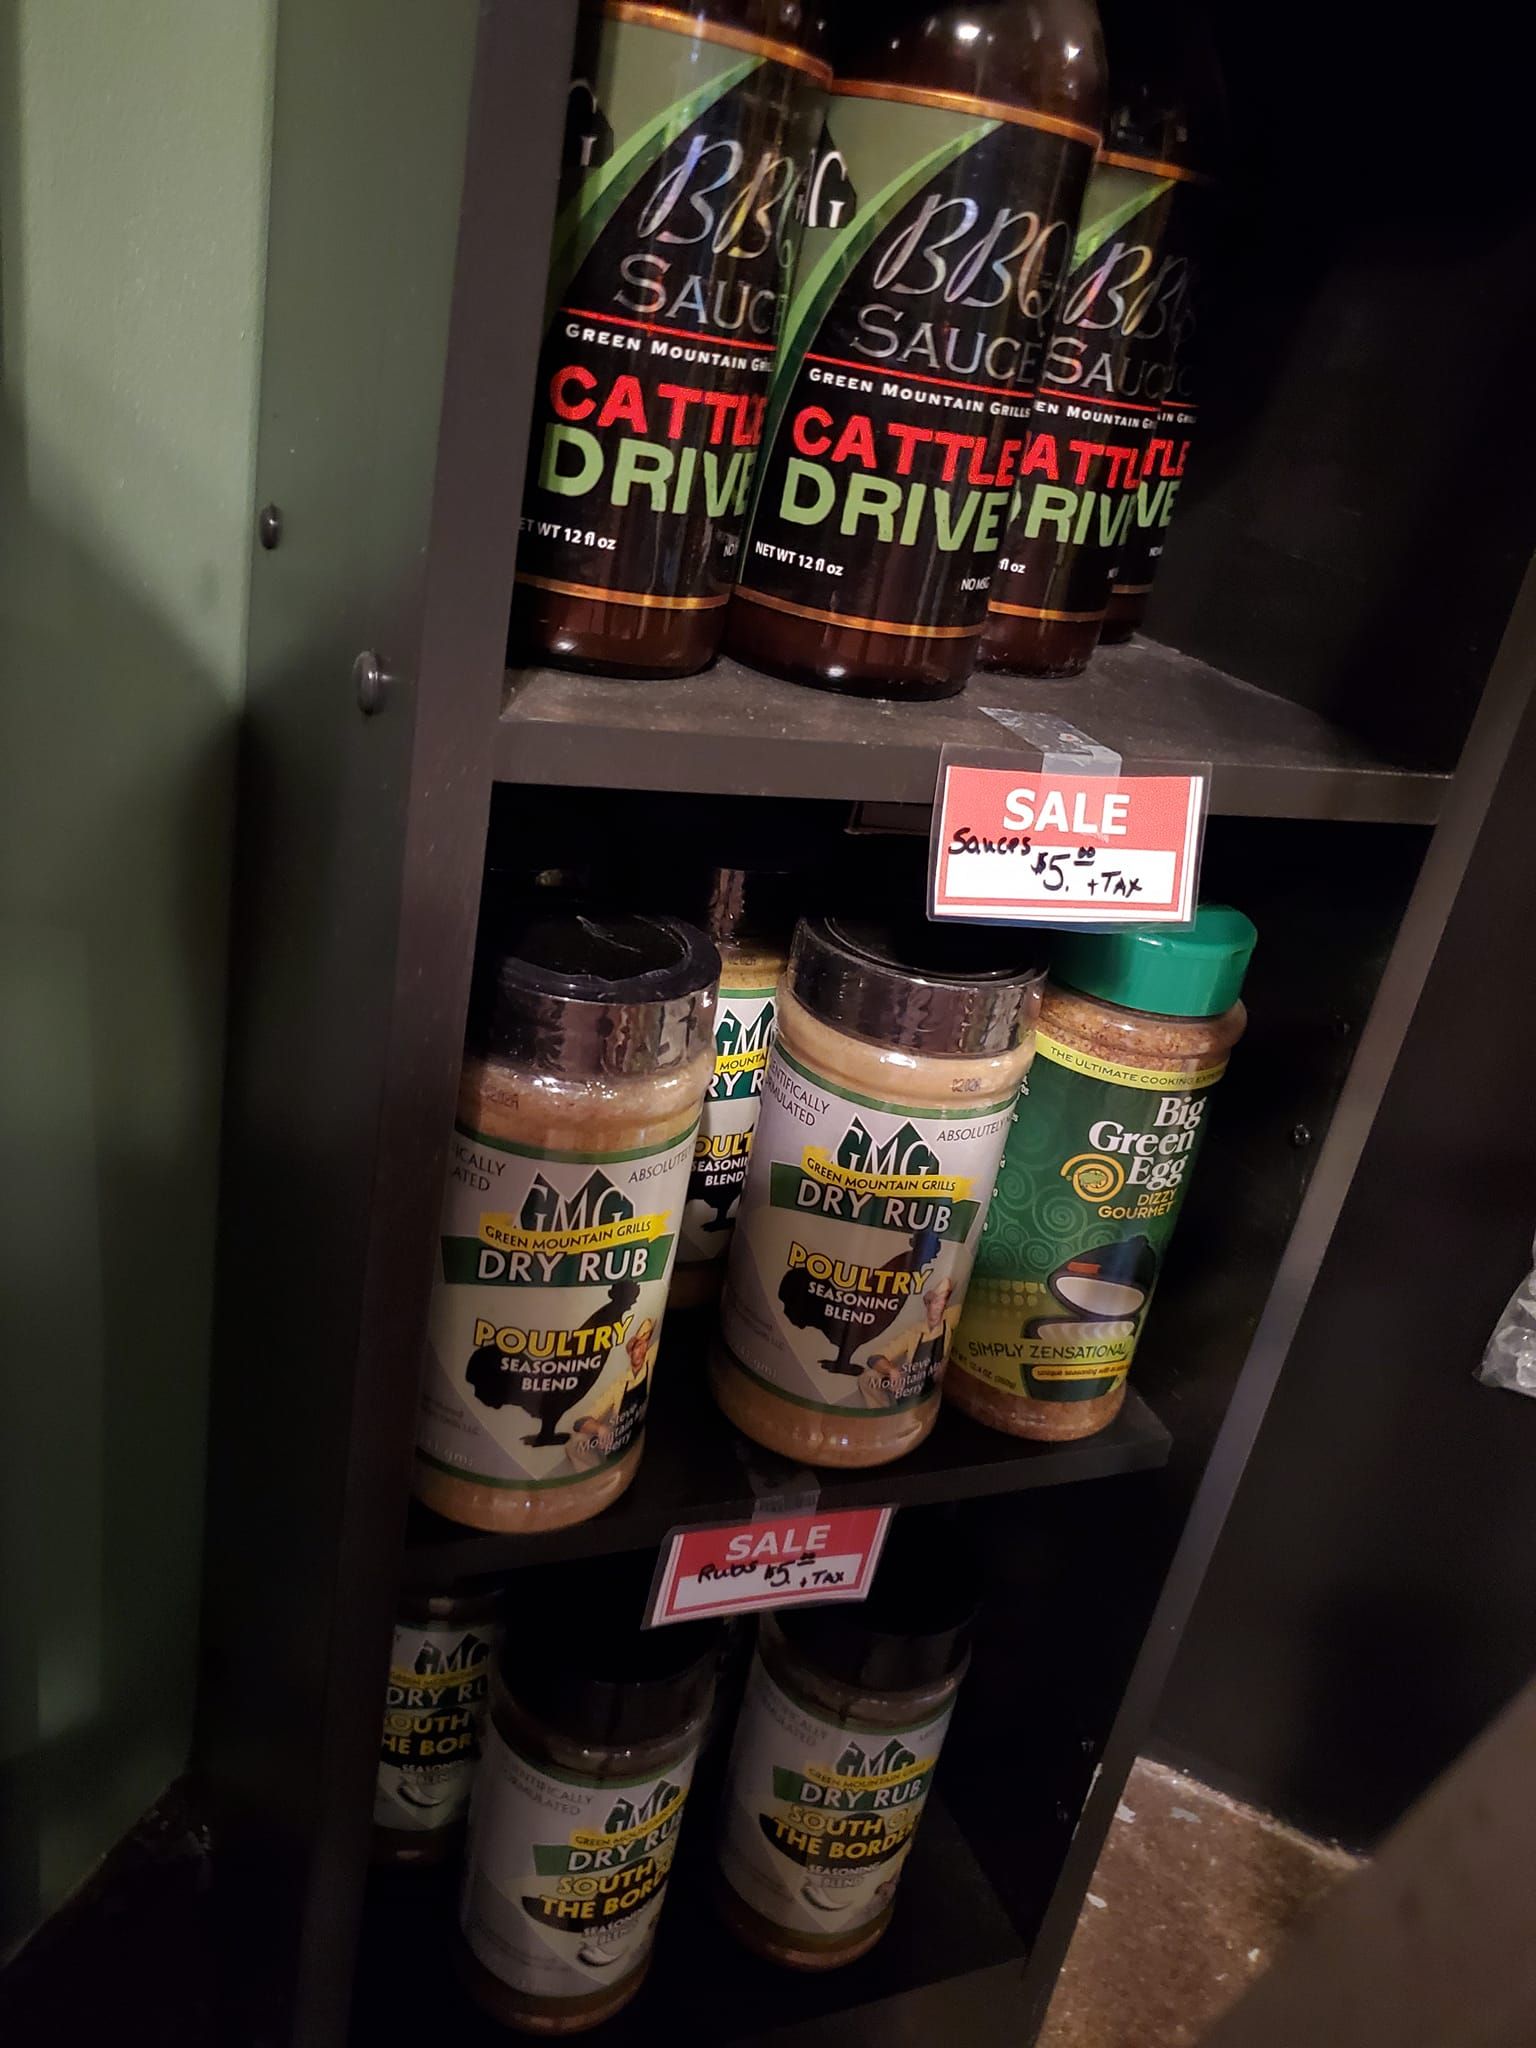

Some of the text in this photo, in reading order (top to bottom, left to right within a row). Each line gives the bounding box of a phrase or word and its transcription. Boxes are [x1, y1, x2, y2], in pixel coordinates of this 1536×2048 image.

[565, 323, 641, 351] GREEN
[651, 340, 747, 370] MOUNTAIN
[850, 303, 1036, 383] SAUCE
[809, 368, 873, 393] GREEN
[882, 382, 984, 412] MOUNTAIN
[990, 402, 1031, 418] GRILLS
[1066, 406, 1140, 428] MOUNTAIN
[793, 406, 1021, 487] CATTLE
[779, 457, 1009, 553] DRIVE
[537, 522, 561, 539] WT
[563, 528, 581, 543] 12
[584, 529, 597, 546] fl
[597, 536, 617, 550] oz
[755, 541, 845, 577] NET WT 12 fl oz
[1010, 563, 1027, 575] oz
[1002, 787, 1131, 836] SALE
[948, 828, 1032, 855] Sauces
[719, 1053, 767, 1071] MOUNTA
[1050, 1046, 1073, 1063] THE
[1075, 1058, 1139, 1082] ULTIMATE
[1141, 1072, 1193, 1086] COOKING
[1153, 1096, 1207, 1131] Big
[836, 1120, 942, 1177] GMG
[1088, 1121, 1195, 1156] Green
[807, 1157, 956, 1192] GREEN MOUNTAIN GRILLS
[1126, 1155, 1189, 1191] Egg
[514, 1172, 634, 1233] GMG
[796, 1178, 952, 1233] DRY RUB
[1098, 1202, 1175, 1220] GOURMET
[1137, 1188, 1178, 1207] DIZZY
[486, 1220, 651, 1250] GREEN MOUNTAIN GRILLS
[477, 1247, 648, 1283] DRY RUB
[787, 1241, 933, 1295] POULTRY
[808, 1281, 900, 1311] SEASONING
[825, 1304, 876, 1326] BLEND
[473, 1314, 635, 1359] POULTRY
[969, 1341, 1025, 1359] SIMPLY
[500, 1355, 602, 1375] SEASONING
[521, 1376, 579, 1392] BLEND
[725, 1525, 831, 1562] SALE
[698, 1560, 758, 1584] Rubs
[386, 1685, 444, 1707] DRY
[800, 1779, 922, 1809] DRY RUB
[774, 1818, 826, 1856] THE
[787, 1804, 885, 1838] SOUTH
[568, 1846, 637, 1872] DRY
[559, 1858, 656, 1897] SOUTH
[540, 1894, 596, 1920] THE
